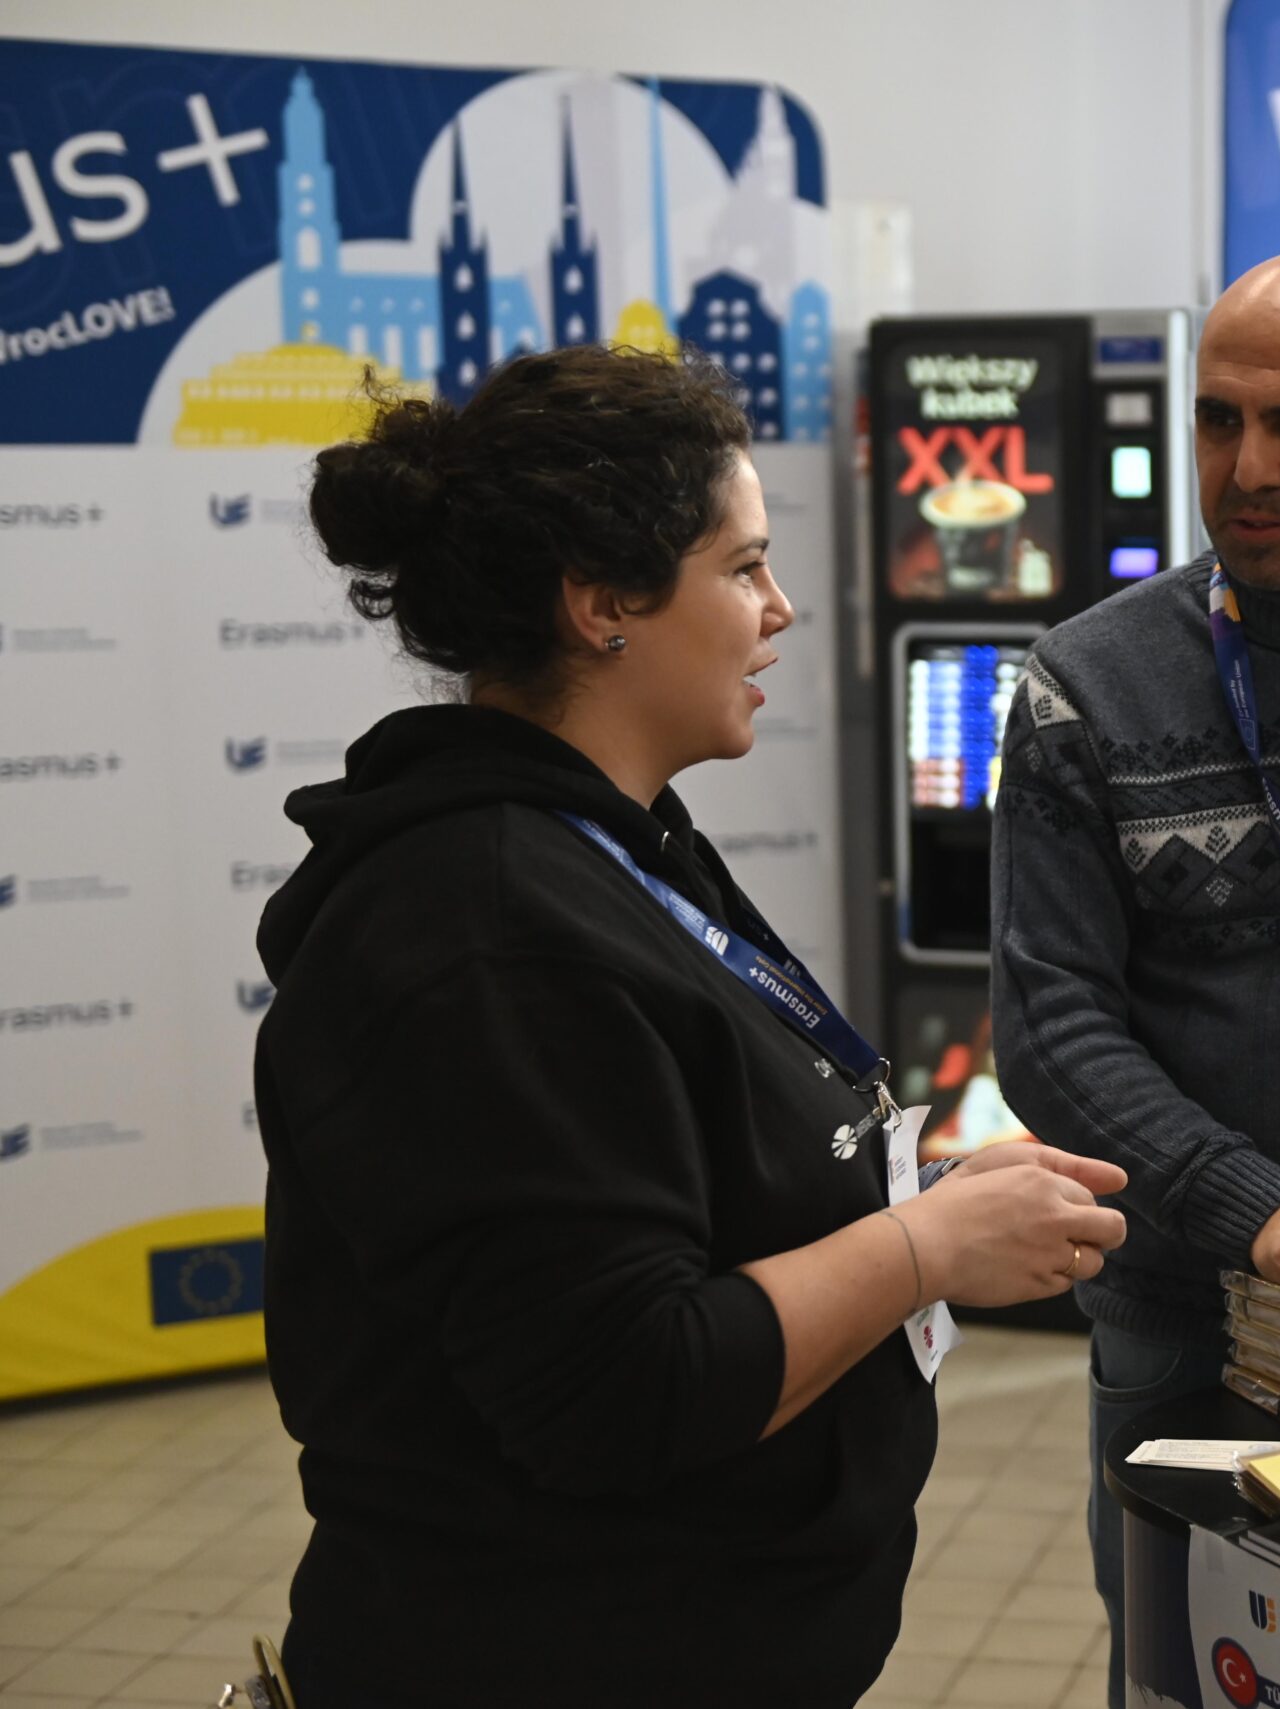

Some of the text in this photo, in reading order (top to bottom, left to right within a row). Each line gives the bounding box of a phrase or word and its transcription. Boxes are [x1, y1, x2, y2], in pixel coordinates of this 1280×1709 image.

[0, 286, 176, 364] rocLOVE!
[898, 425, 1055, 494] XXL
[749, 967, 821, 1030] Erasmus+
